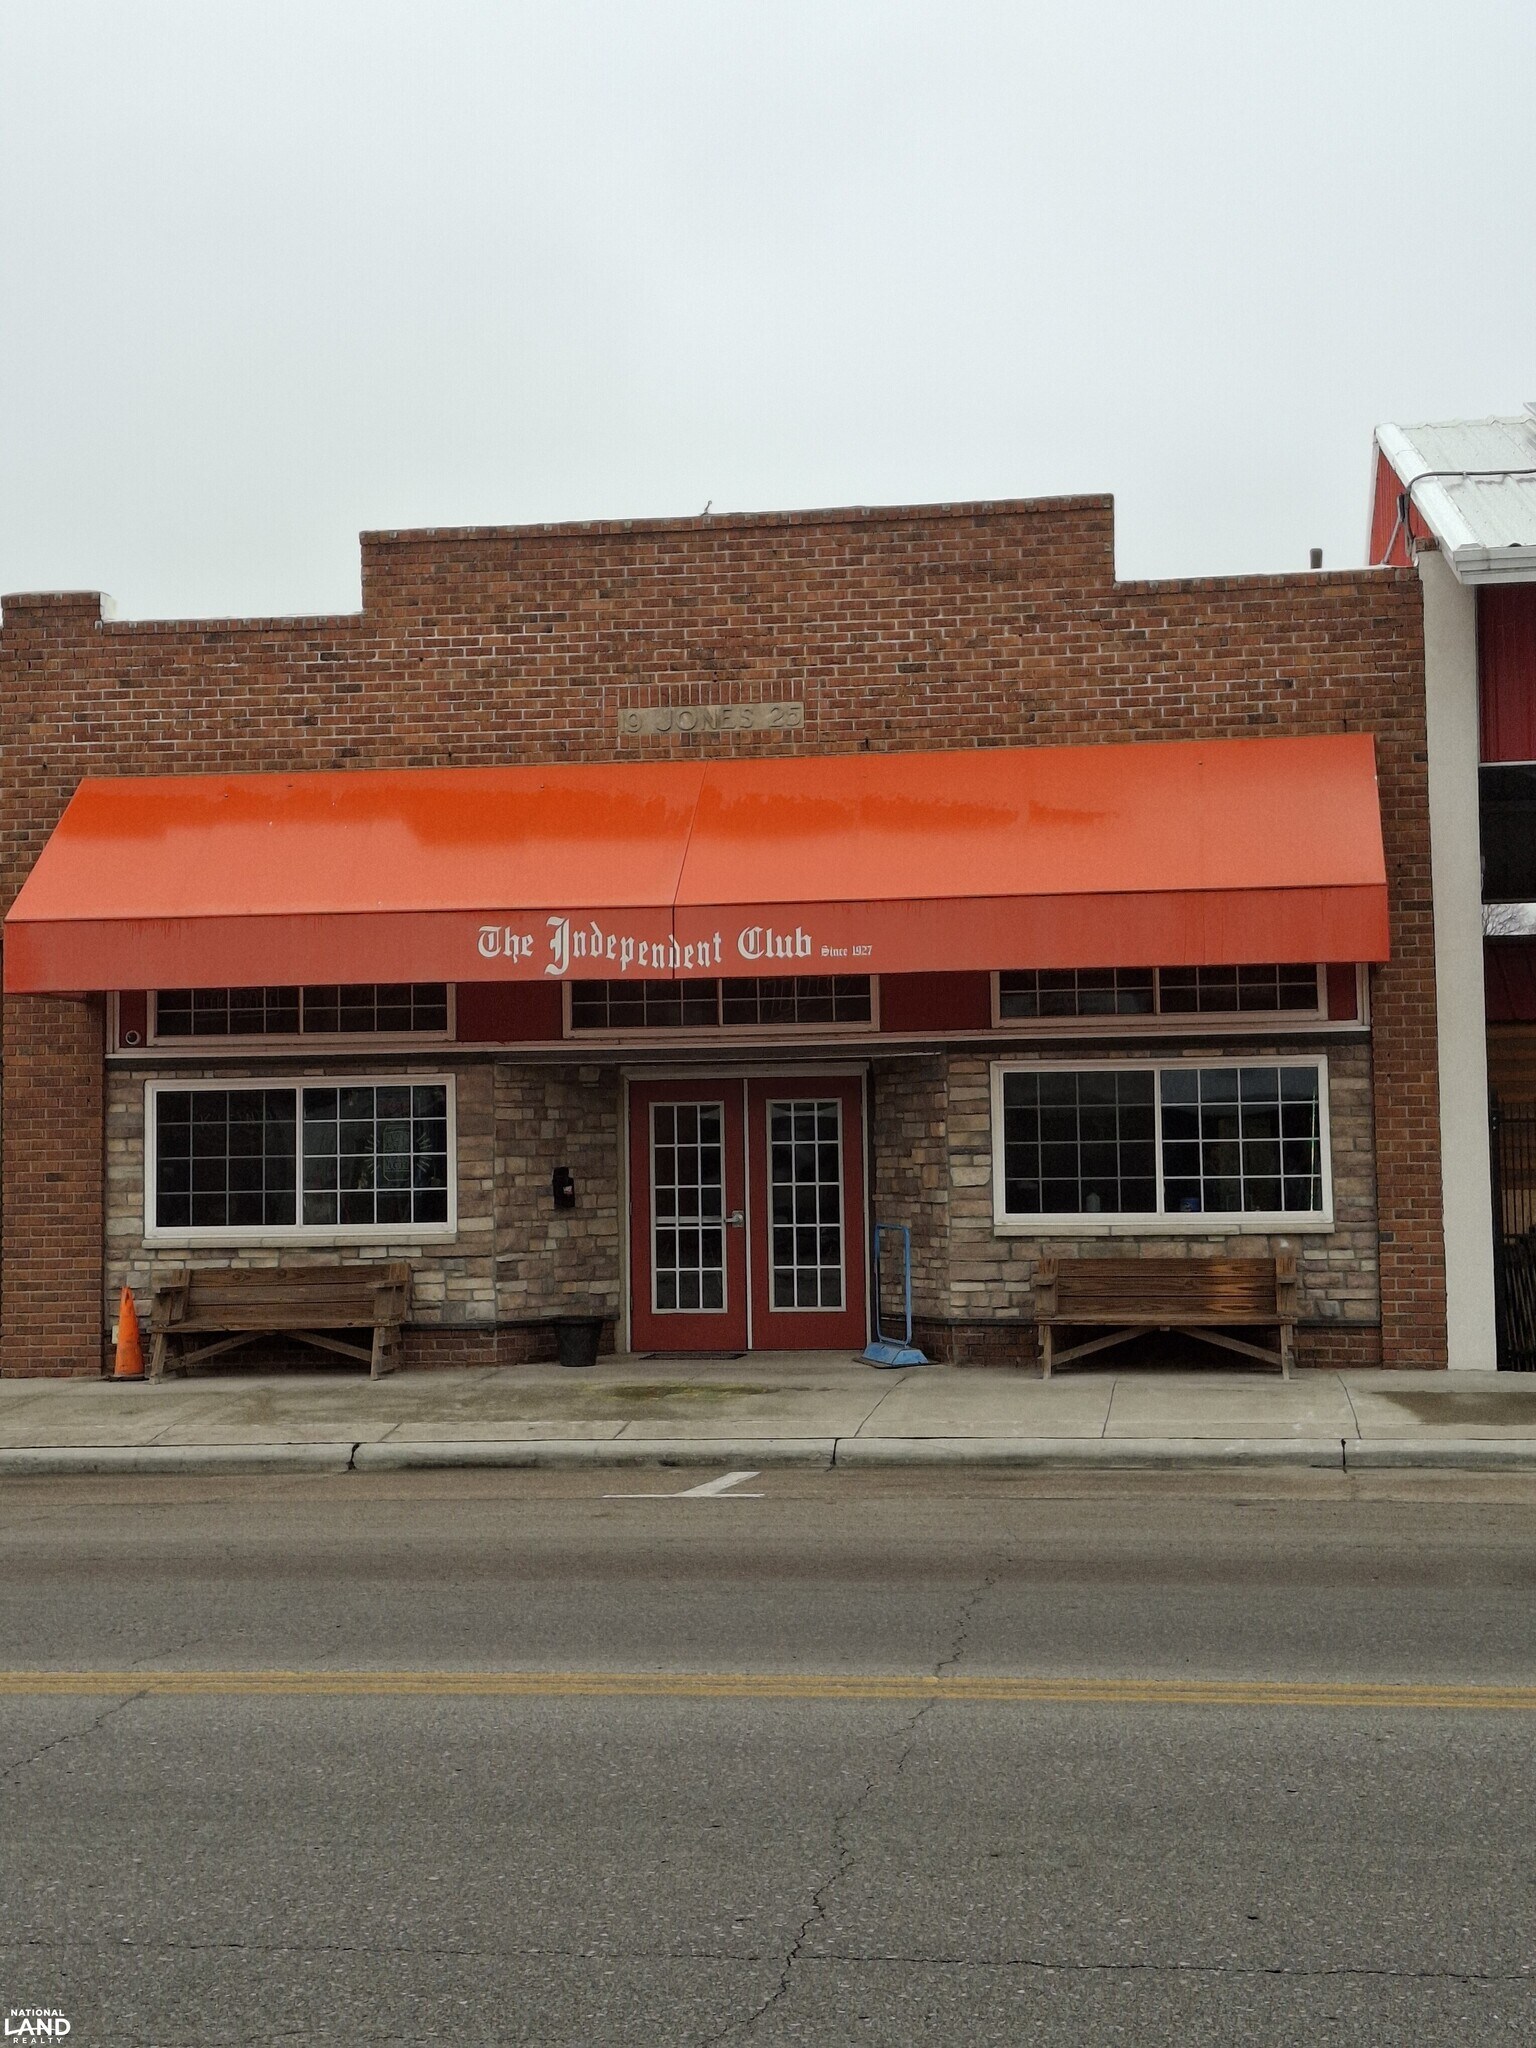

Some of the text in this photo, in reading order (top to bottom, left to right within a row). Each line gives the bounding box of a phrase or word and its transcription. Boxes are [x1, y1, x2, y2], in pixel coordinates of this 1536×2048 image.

[656, 708, 754, 732] JONES
[477, 916, 873, 976] The Independent Club Since 1927
